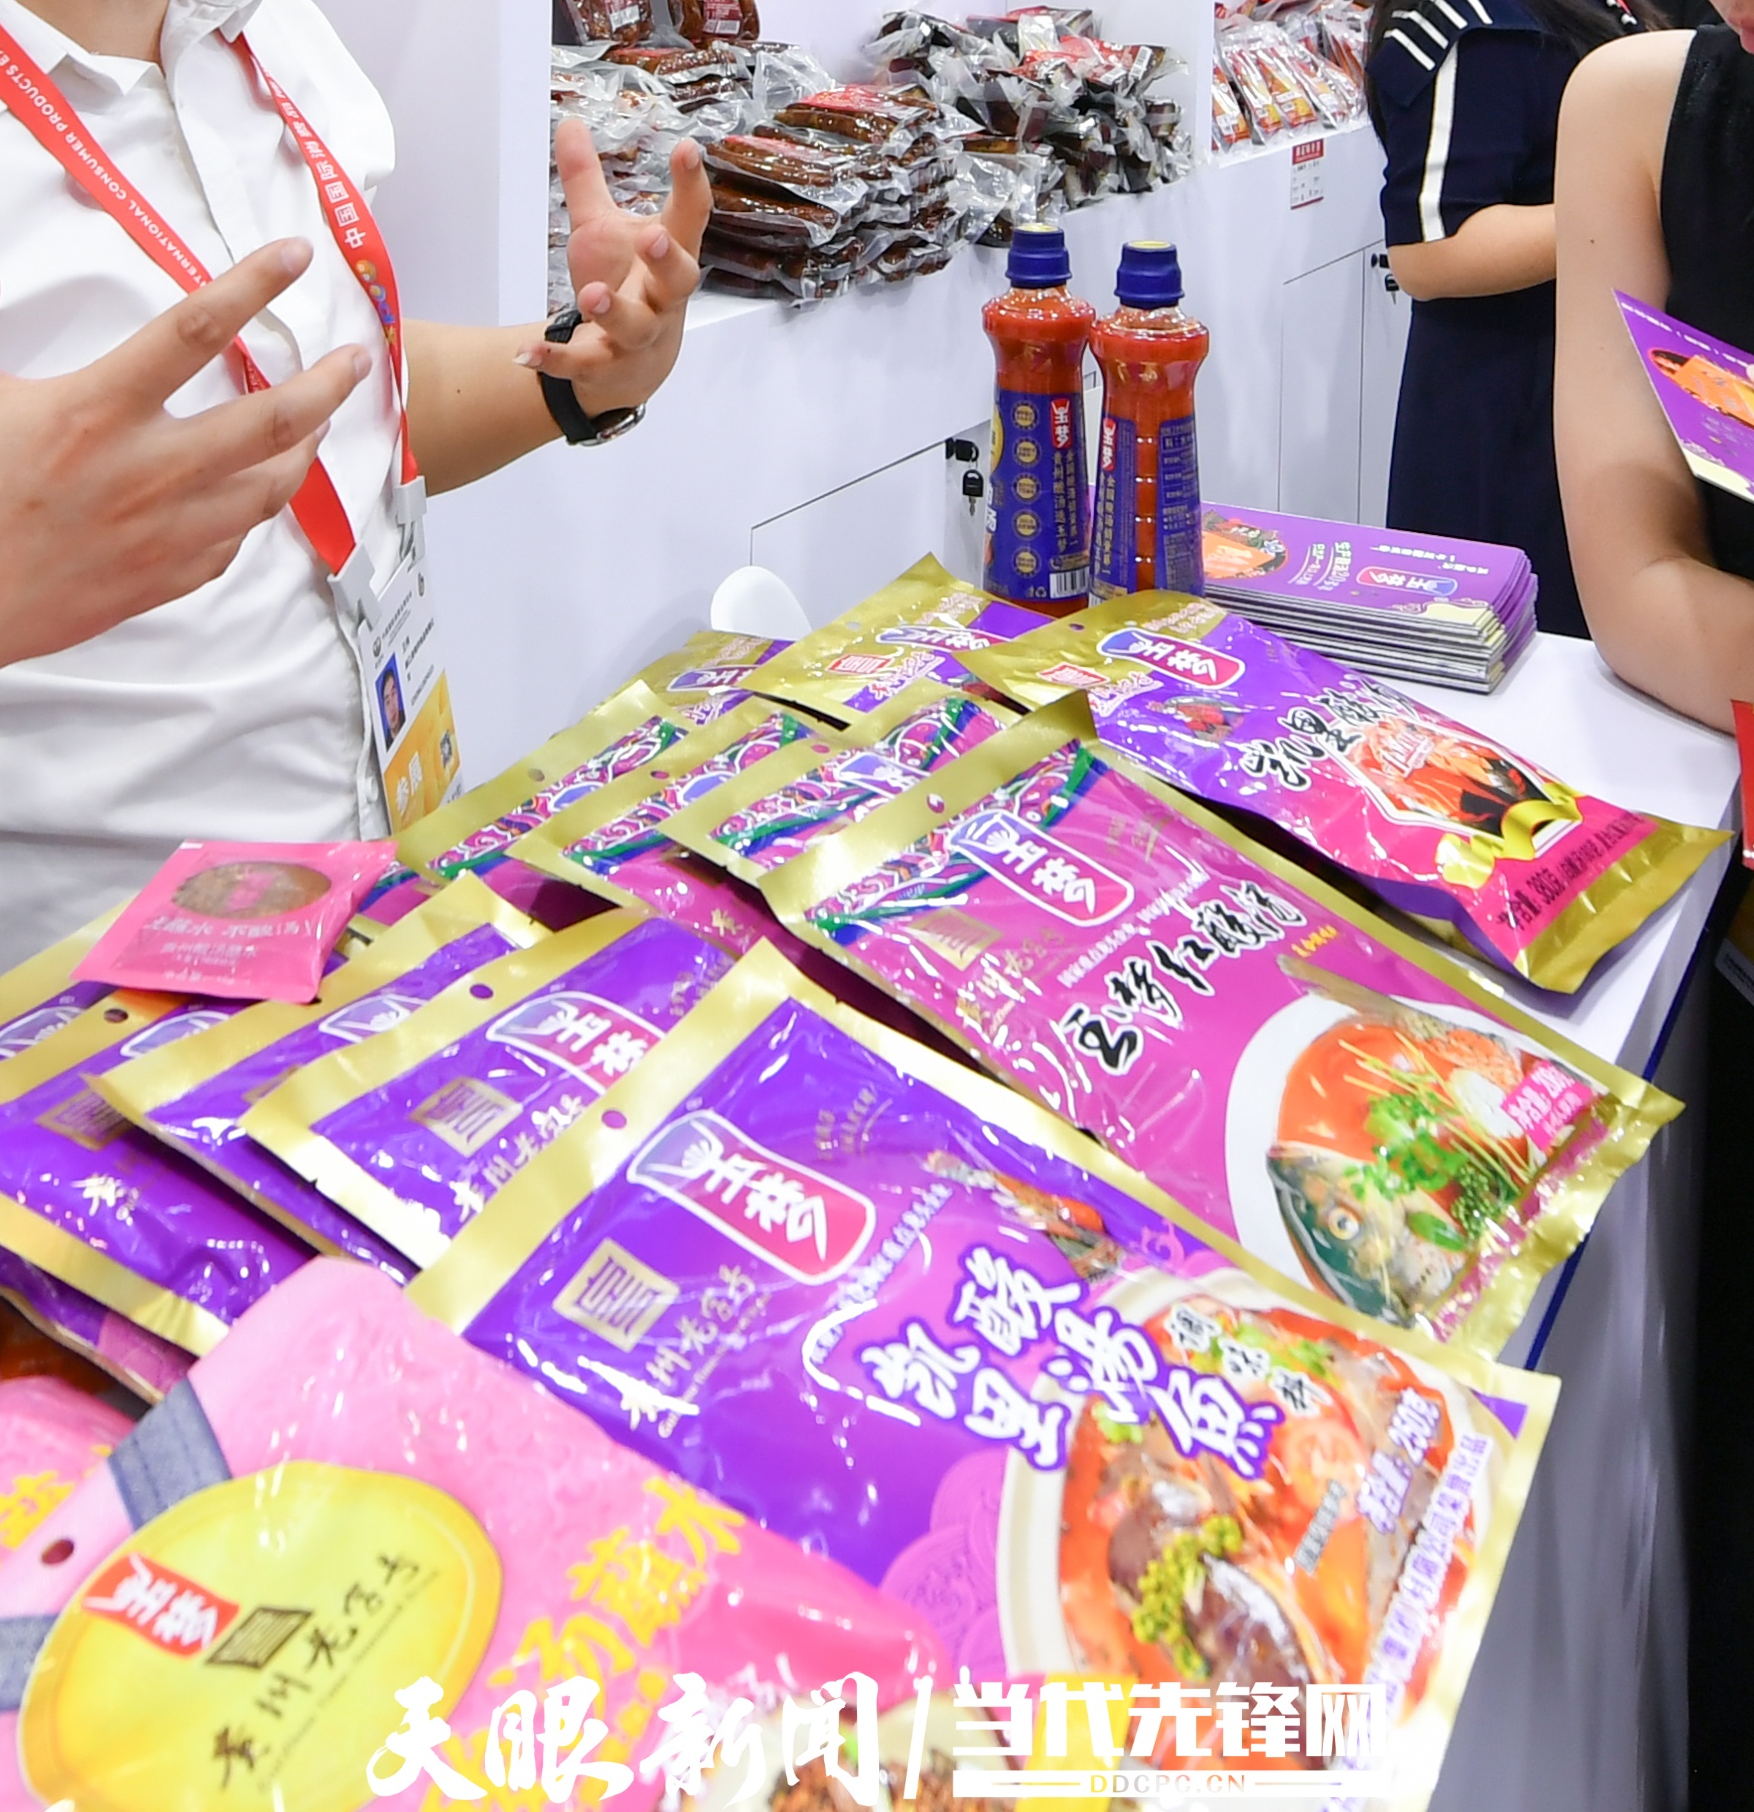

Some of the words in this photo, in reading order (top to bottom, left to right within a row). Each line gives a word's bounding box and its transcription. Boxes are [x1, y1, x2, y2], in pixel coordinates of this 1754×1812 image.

[6, 64, 73, 144] PRODUCTS
[67, 130, 126, 201] CONSUMER
[127, 198, 212, 291] NTERNATIONAL
[1051, 400, 1070, 448] 玉梦
[1114, 630, 1222, 685] 玉梦
[988, 824, 1097, 918] 玉梦
[682, 1133, 829, 1263] 玉梦
[90, 1556, 237, 1654] 玉梦
